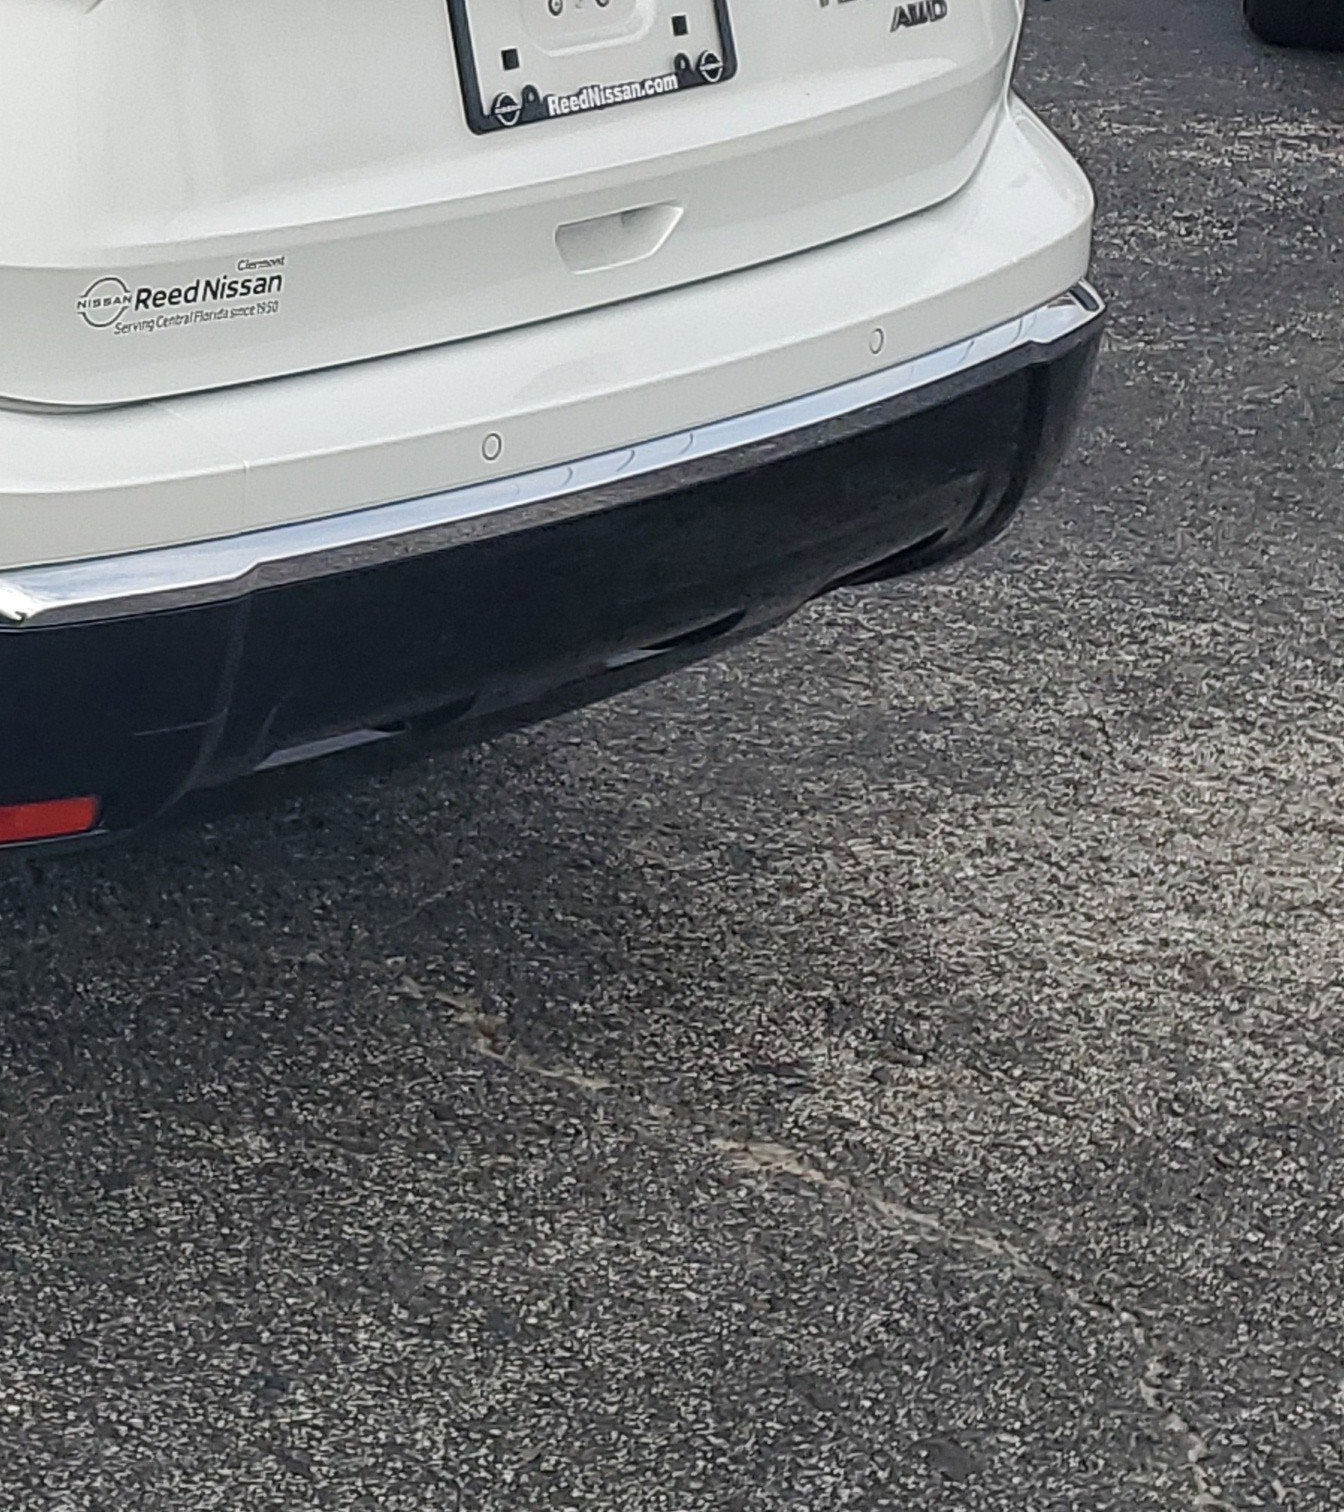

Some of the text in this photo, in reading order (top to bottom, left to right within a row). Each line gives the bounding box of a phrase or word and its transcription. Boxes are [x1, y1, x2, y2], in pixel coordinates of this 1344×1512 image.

[547, 74, 679, 116] ReedNissan.com
[76, 294, 133, 310] NISSAN
[134, 273, 283, 311] Reed Nissan
[113, 319, 154, 335] Serving
[155, 311, 193, 329] Central
